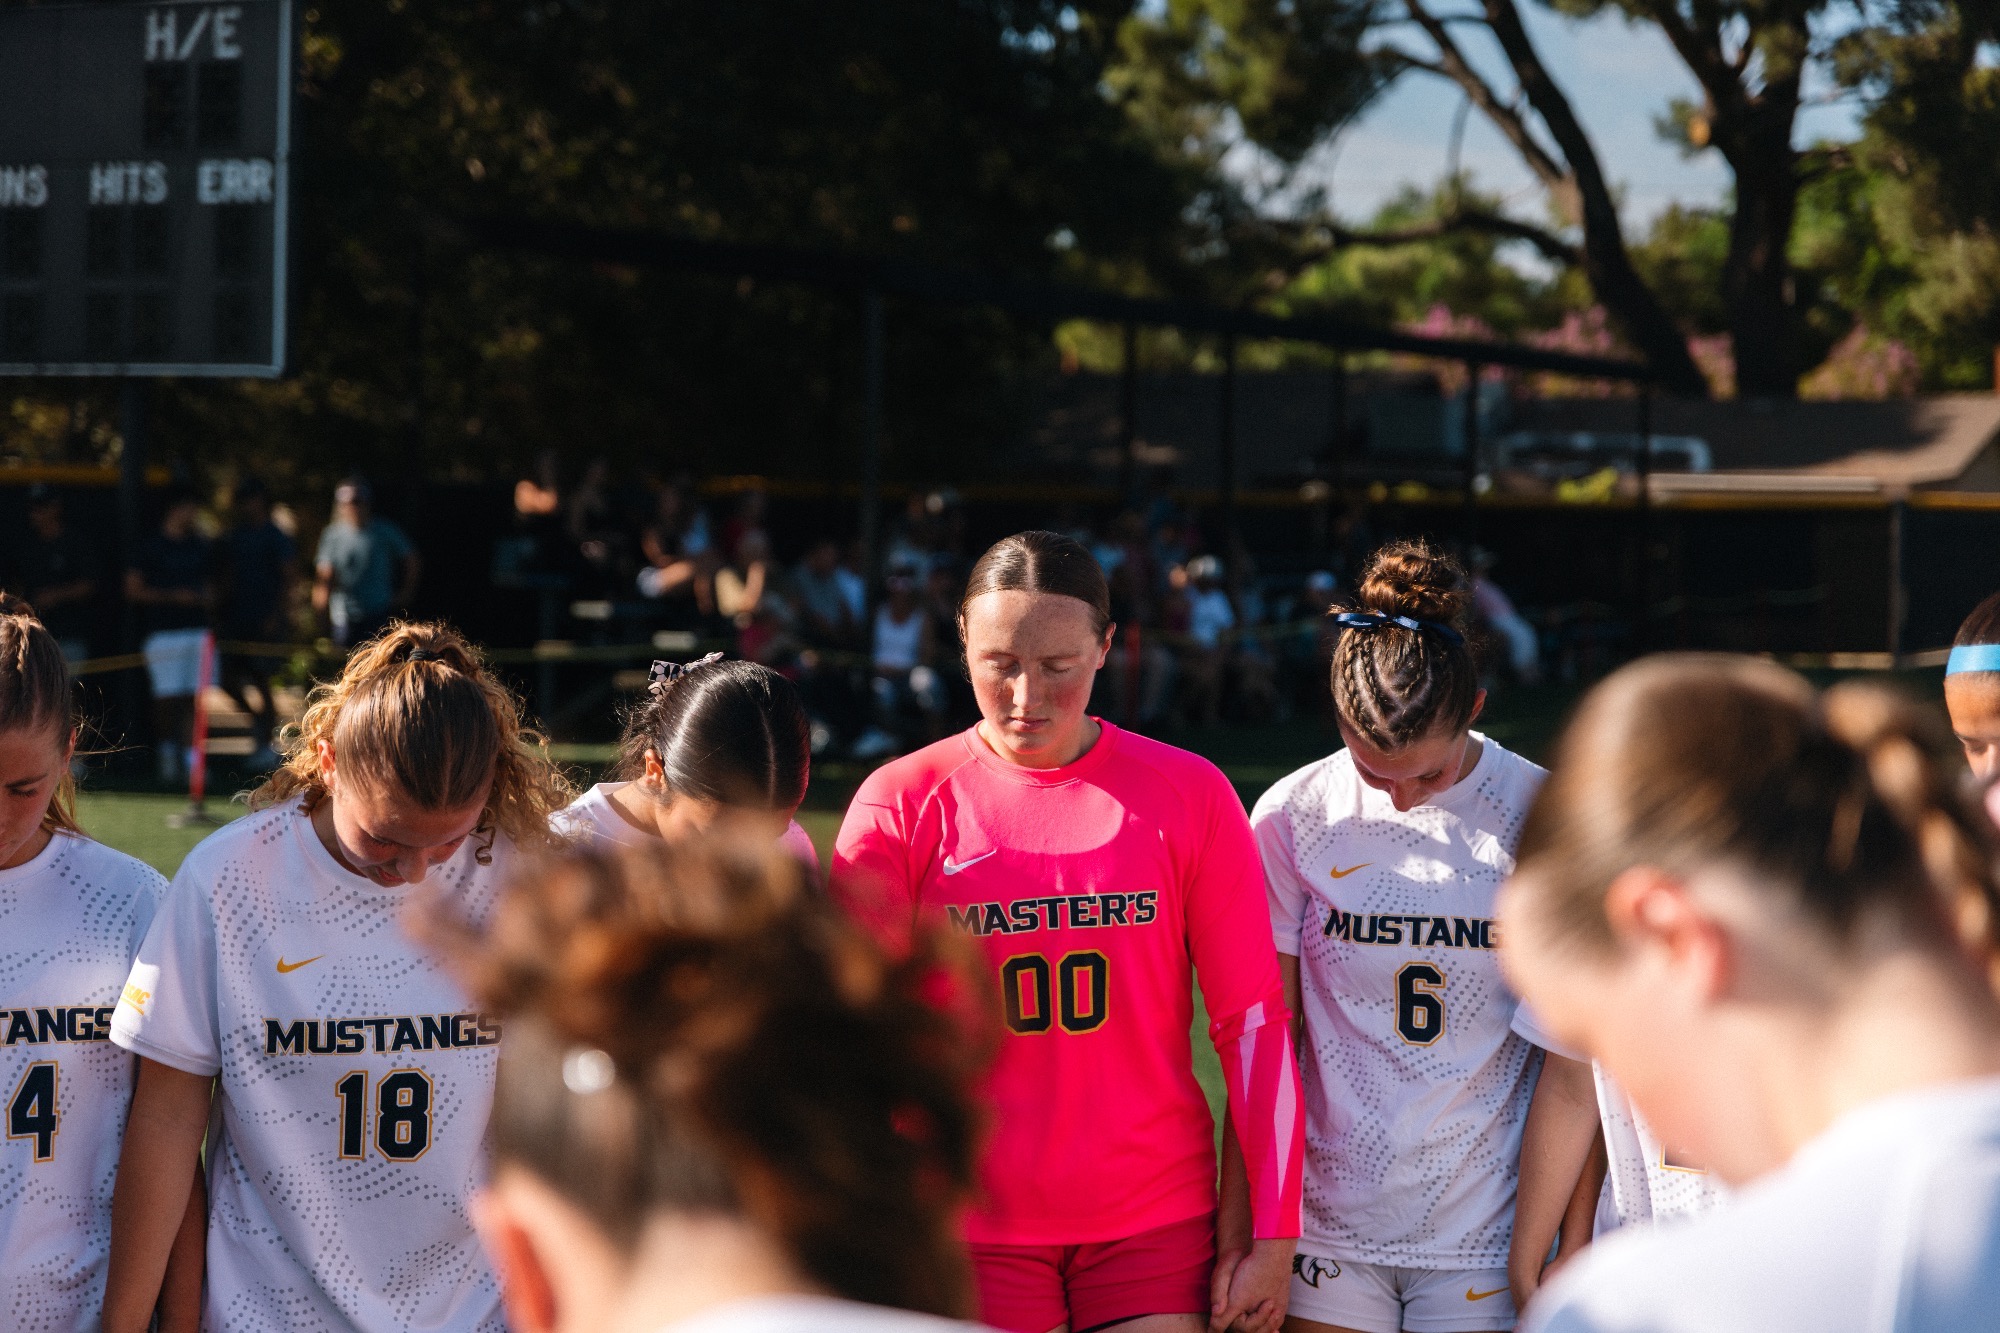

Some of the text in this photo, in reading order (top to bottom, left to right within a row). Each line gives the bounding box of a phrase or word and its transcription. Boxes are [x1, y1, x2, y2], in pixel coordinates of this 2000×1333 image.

[146, 8, 243, 61] H/E
[0, 158, 274, 206] NS HITS ERR
[944, 890, 1159, 936] MASTER'S
[999, 949, 1110, 1036] 00
[1394, 961, 1446, 1047] 6
[264, 1012, 503, 1055] MUSTANGS
[6, 1060, 60, 1163] 4
[335, 1067, 434, 1163] 18
